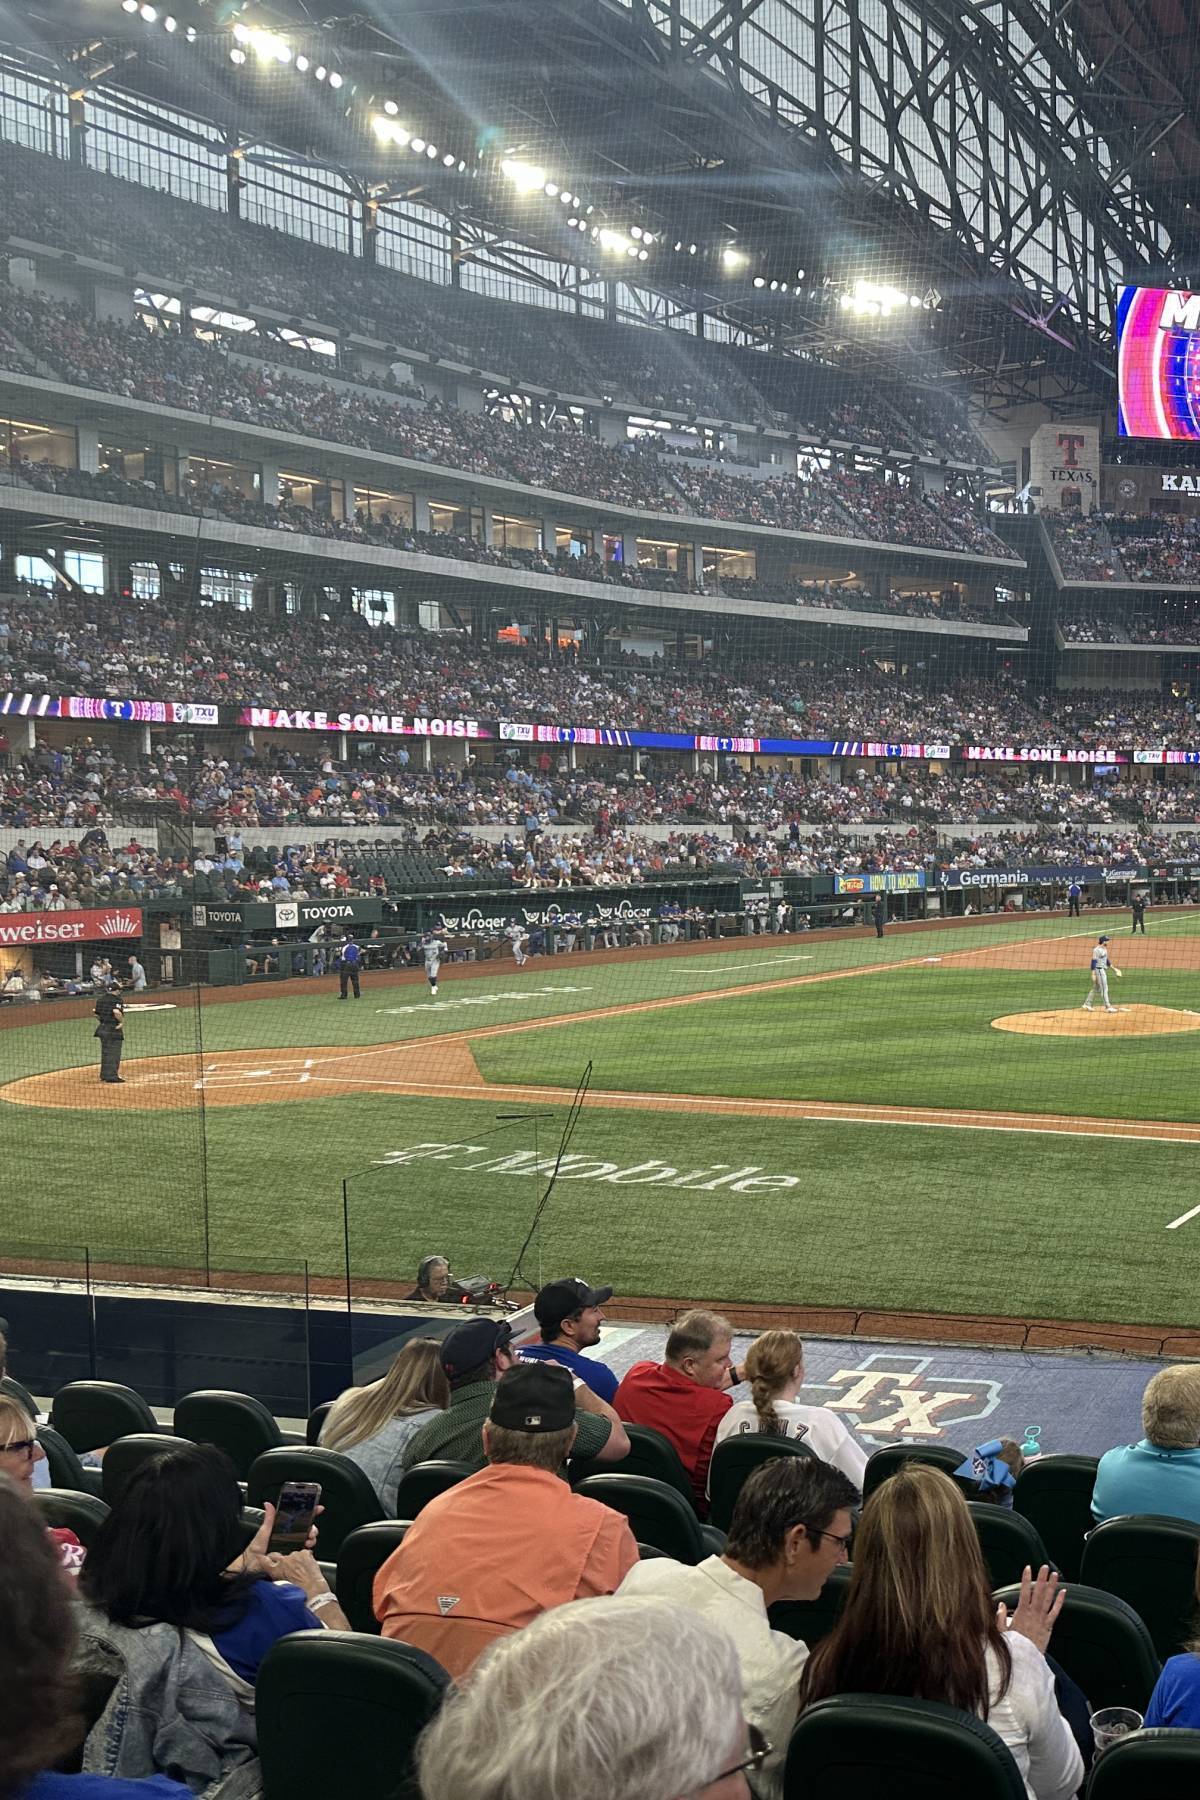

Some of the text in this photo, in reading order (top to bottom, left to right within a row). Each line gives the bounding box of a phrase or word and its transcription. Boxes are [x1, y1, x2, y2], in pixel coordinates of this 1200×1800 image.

[1057, 433, 1084, 466] T
[1051, 470, 1093, 483] TEXAS
[194, 707, 215, 717] TXU
[251, 708, 479, 738] MAKE SOME NOISE
[516, 727, 531, 735] TXU
[968, 747, 1116, 763] MAKE SOME NOISE
[869, 874, 886, 891] HOW
[888, 874, 896, 889] TO
[960, 869, 1029, 885] Germania
[208, 911, 242, 922] TOYOTA
[302, 905, 354, 920] TOYOTA
[462, 909, 506, 930] Kroger
[449, 1150, 800, 1193] Mobile
[822, 1369, 977, 1437] TX
